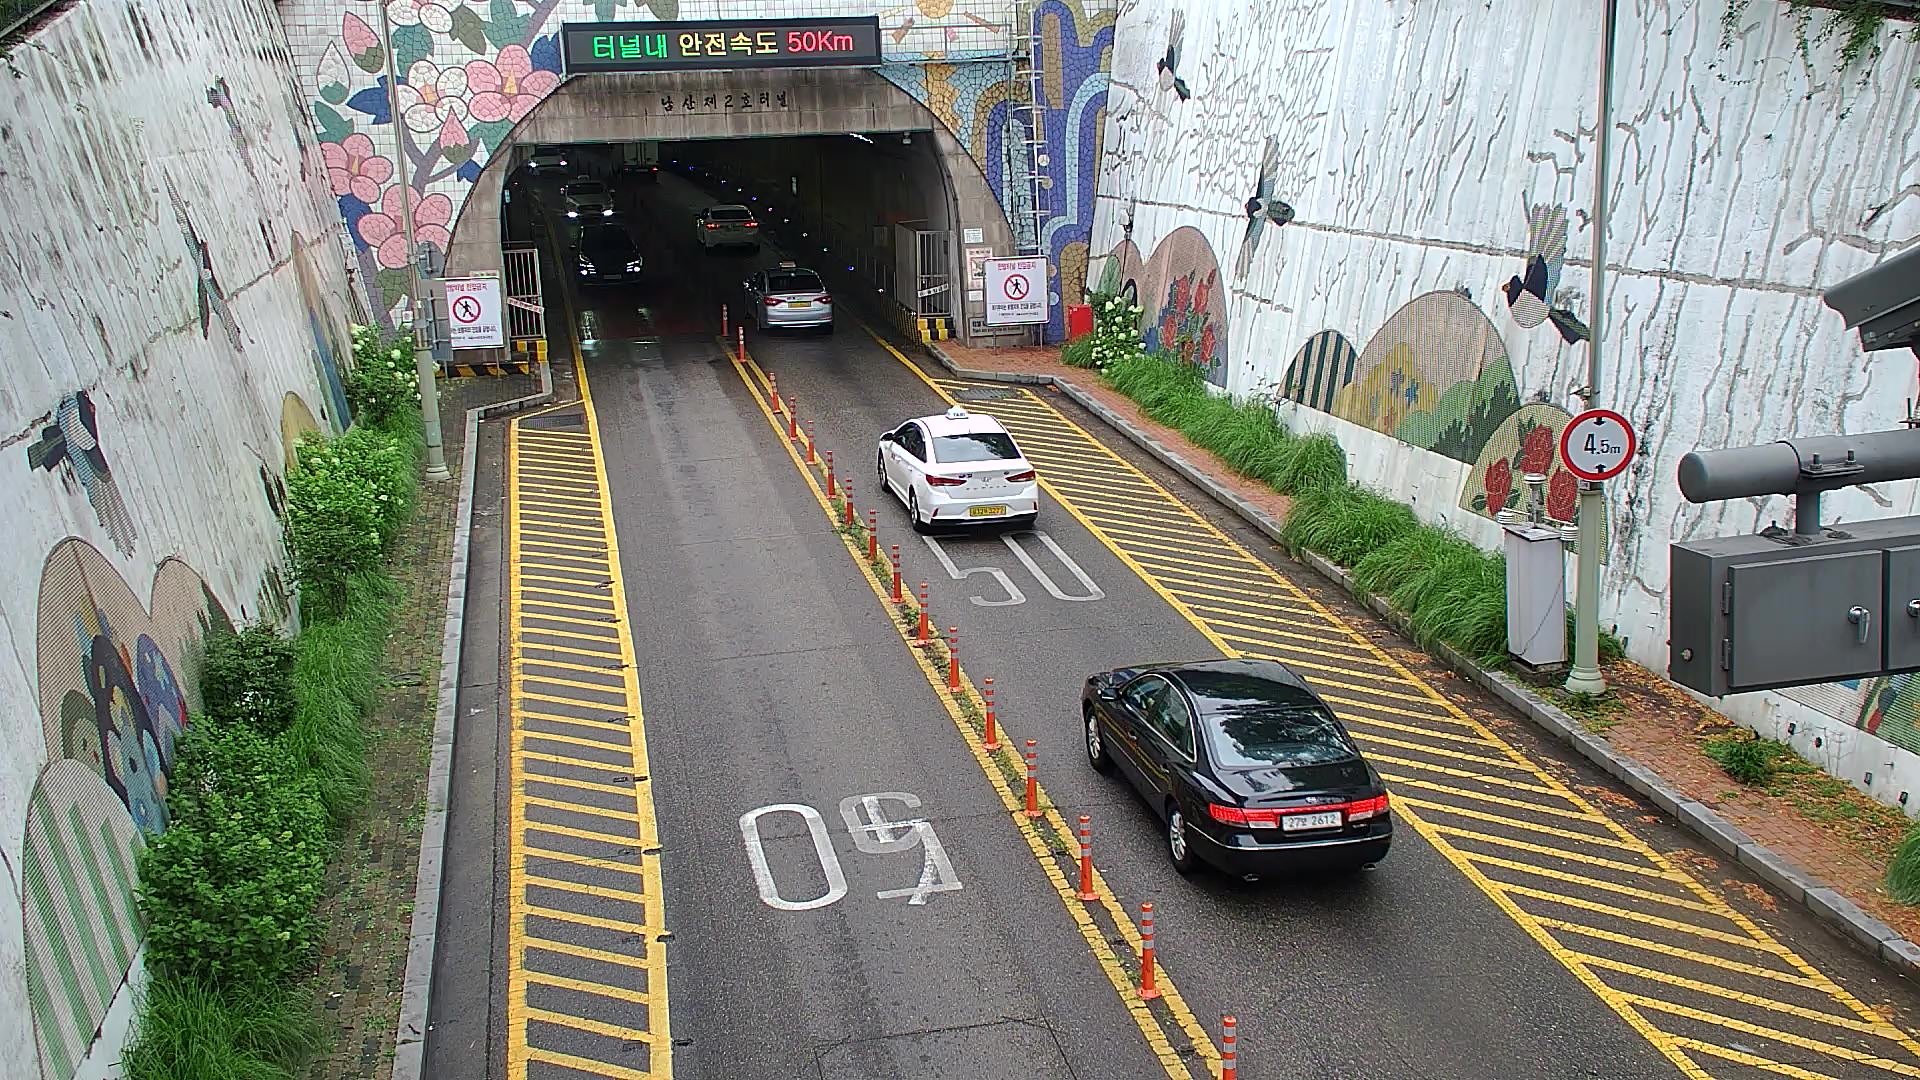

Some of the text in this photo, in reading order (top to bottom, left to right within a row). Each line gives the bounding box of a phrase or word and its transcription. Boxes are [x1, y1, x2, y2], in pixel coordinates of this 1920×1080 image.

[593, 30, 854, 60] 터널내 안전속도 50Km
[1584, 433, 1621, 455] 4.5m
[922, 530, 1106, 607] 50
[1311, 814, 1337, 826] 2612
